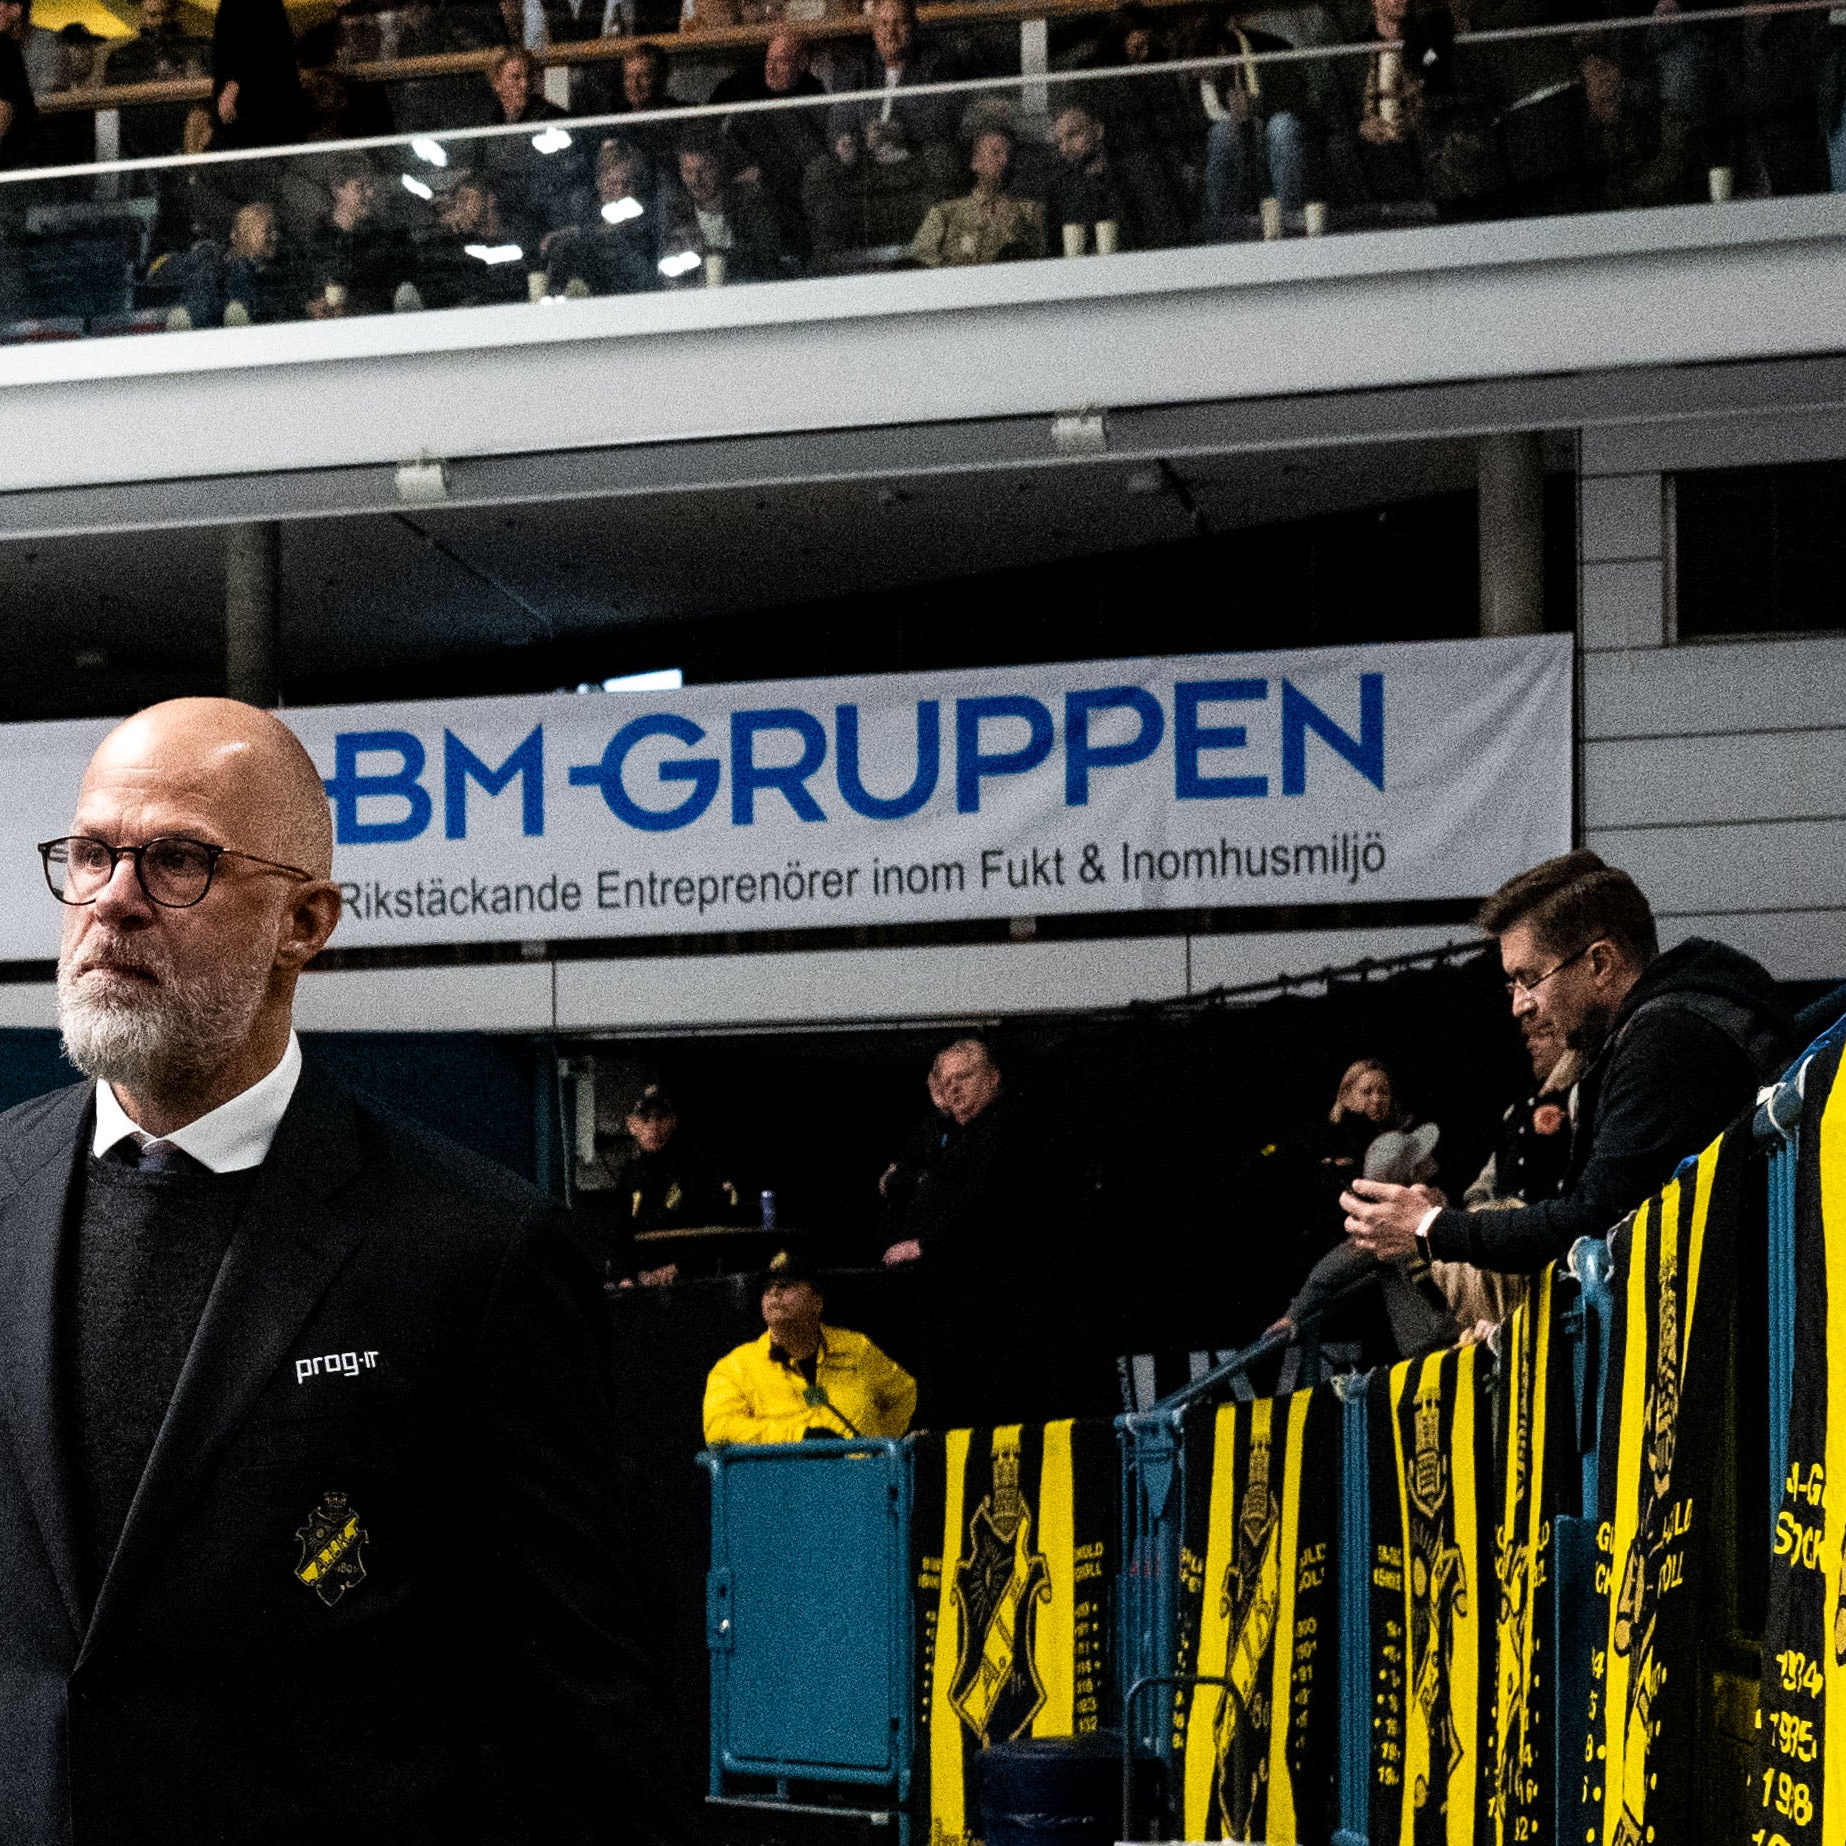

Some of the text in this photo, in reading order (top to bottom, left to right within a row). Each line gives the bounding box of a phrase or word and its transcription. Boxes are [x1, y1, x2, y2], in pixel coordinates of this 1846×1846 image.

[325, 672, 1385, 845] BM-GRUPPEN
[340, 831, 1386, 921] Rikstäckande Entreprenörer inom Fukt & Inomhusmiljö
